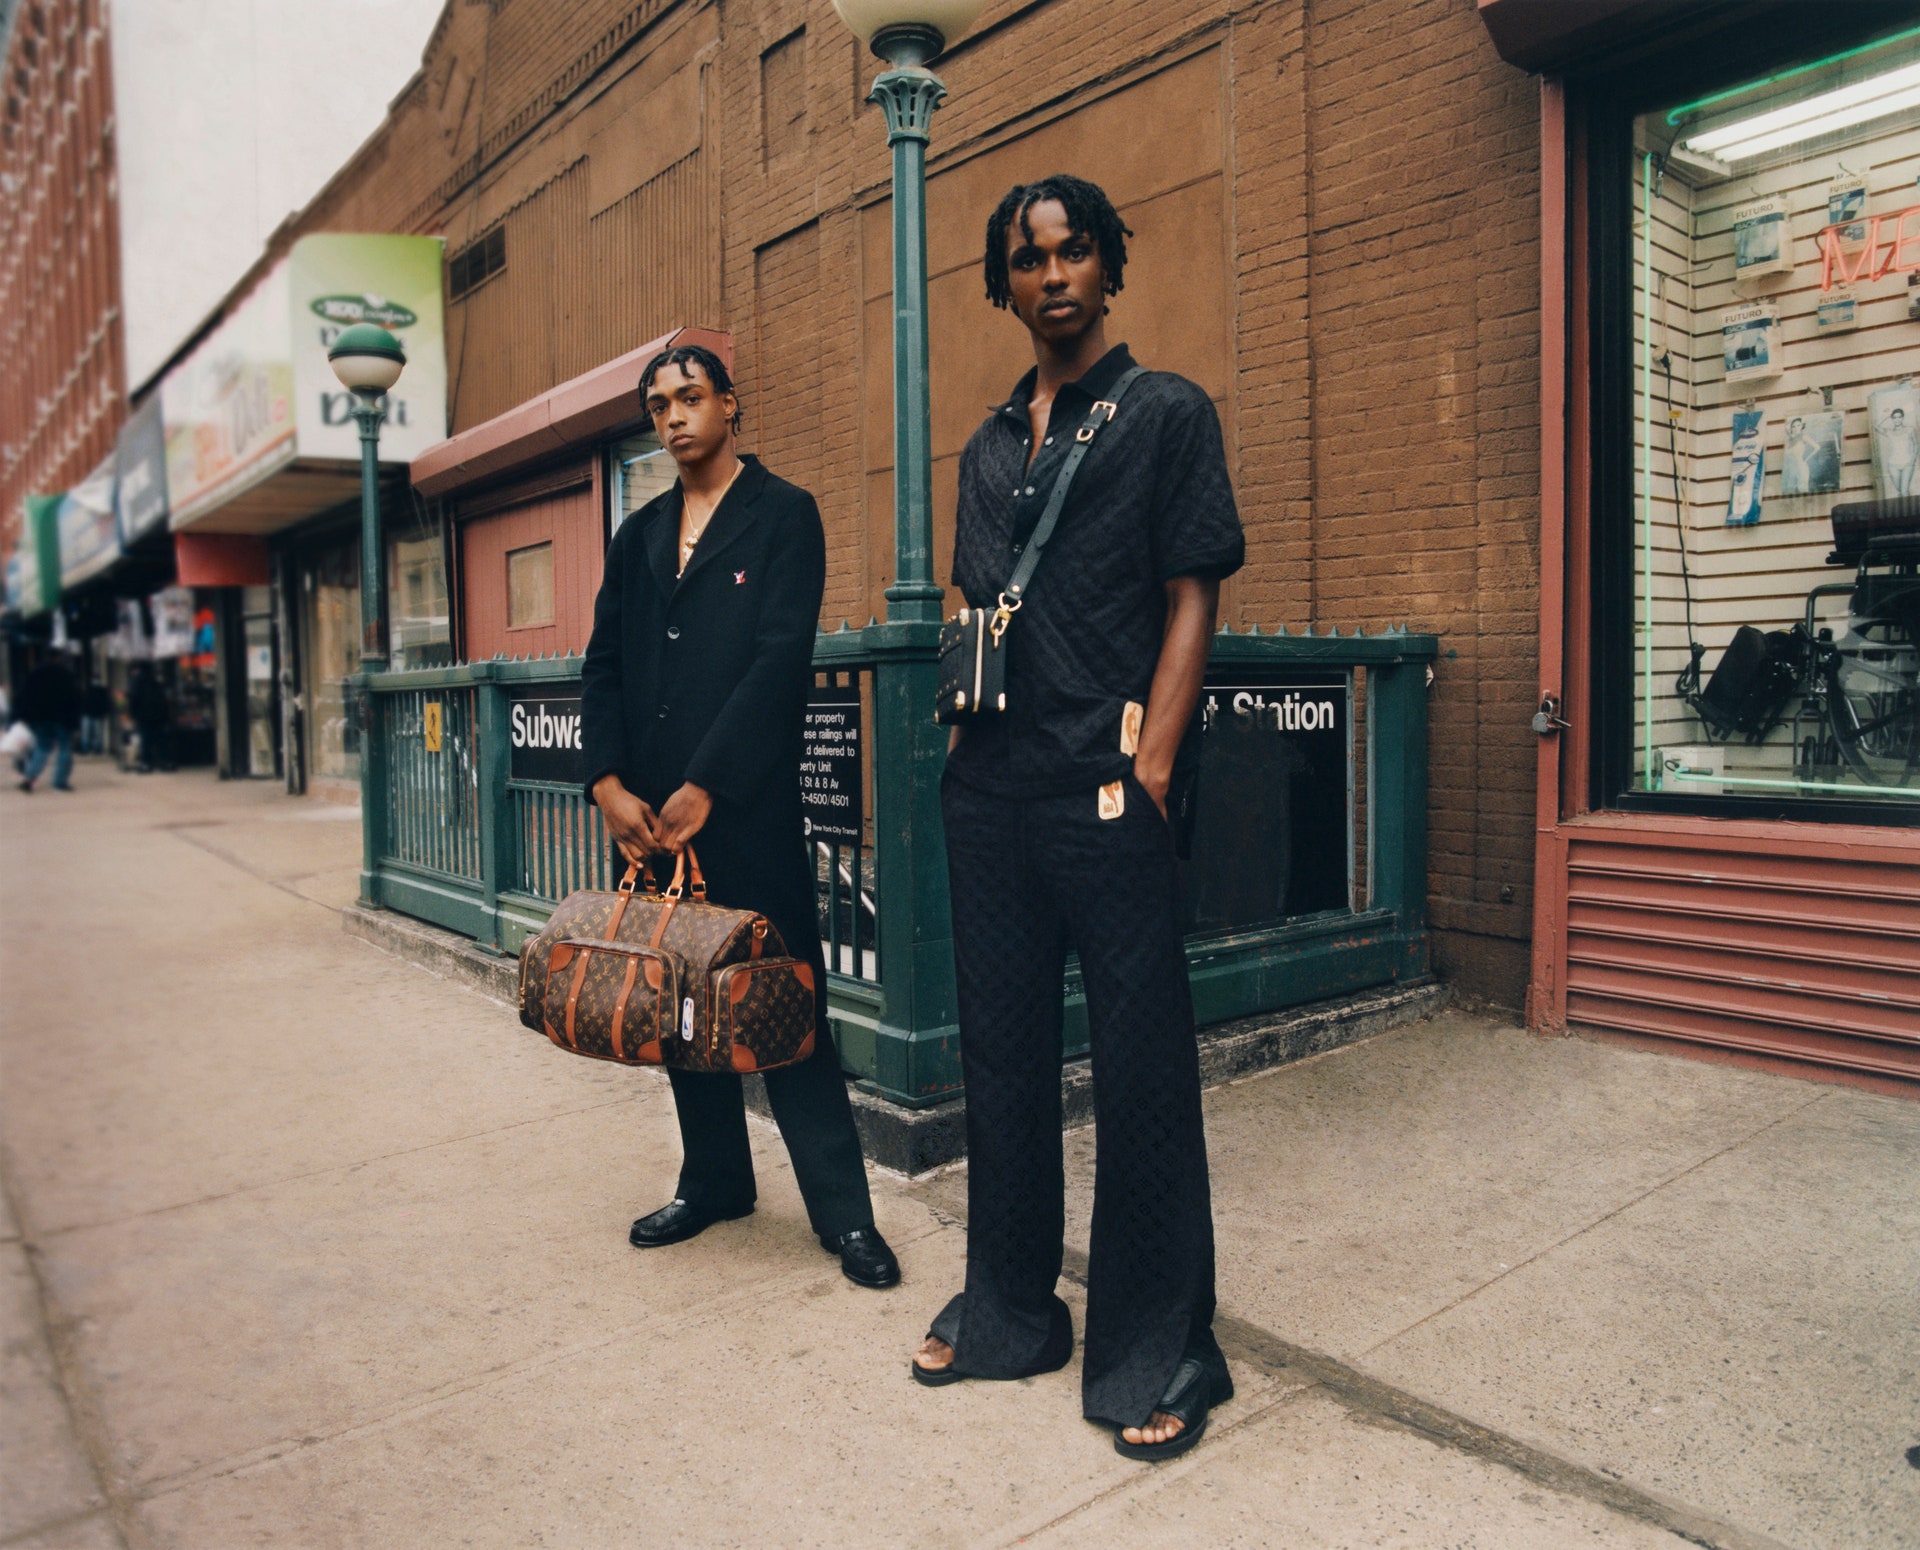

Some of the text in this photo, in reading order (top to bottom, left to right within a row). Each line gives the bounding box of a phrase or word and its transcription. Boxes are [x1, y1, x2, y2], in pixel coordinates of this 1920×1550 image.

[1735, 203, 1774, 219] FUTURO
[1819, 294, 1851, 305] FUTURO
[1725, 309, 1762, 323] FUTURO
[815, 712, 846, 726] property
[818, 728, 843, 742] railings
[845, 728, 857, 740] will
[813, 744, 845, 757] delivered
[848, 746, 855, 757] to
[818, 760, 832, 773] Unit
[805, 776, 813, 788] St
[815, 777, 821, 788] &
[823, 778, 829, 789] 8
[830, 778, 839, 790] Av
[812, 823, 822, 832] New
[822, 824, 832, 833] York
[832, 824, 842, 836] City
[842, 825, 858, 836] Transit
